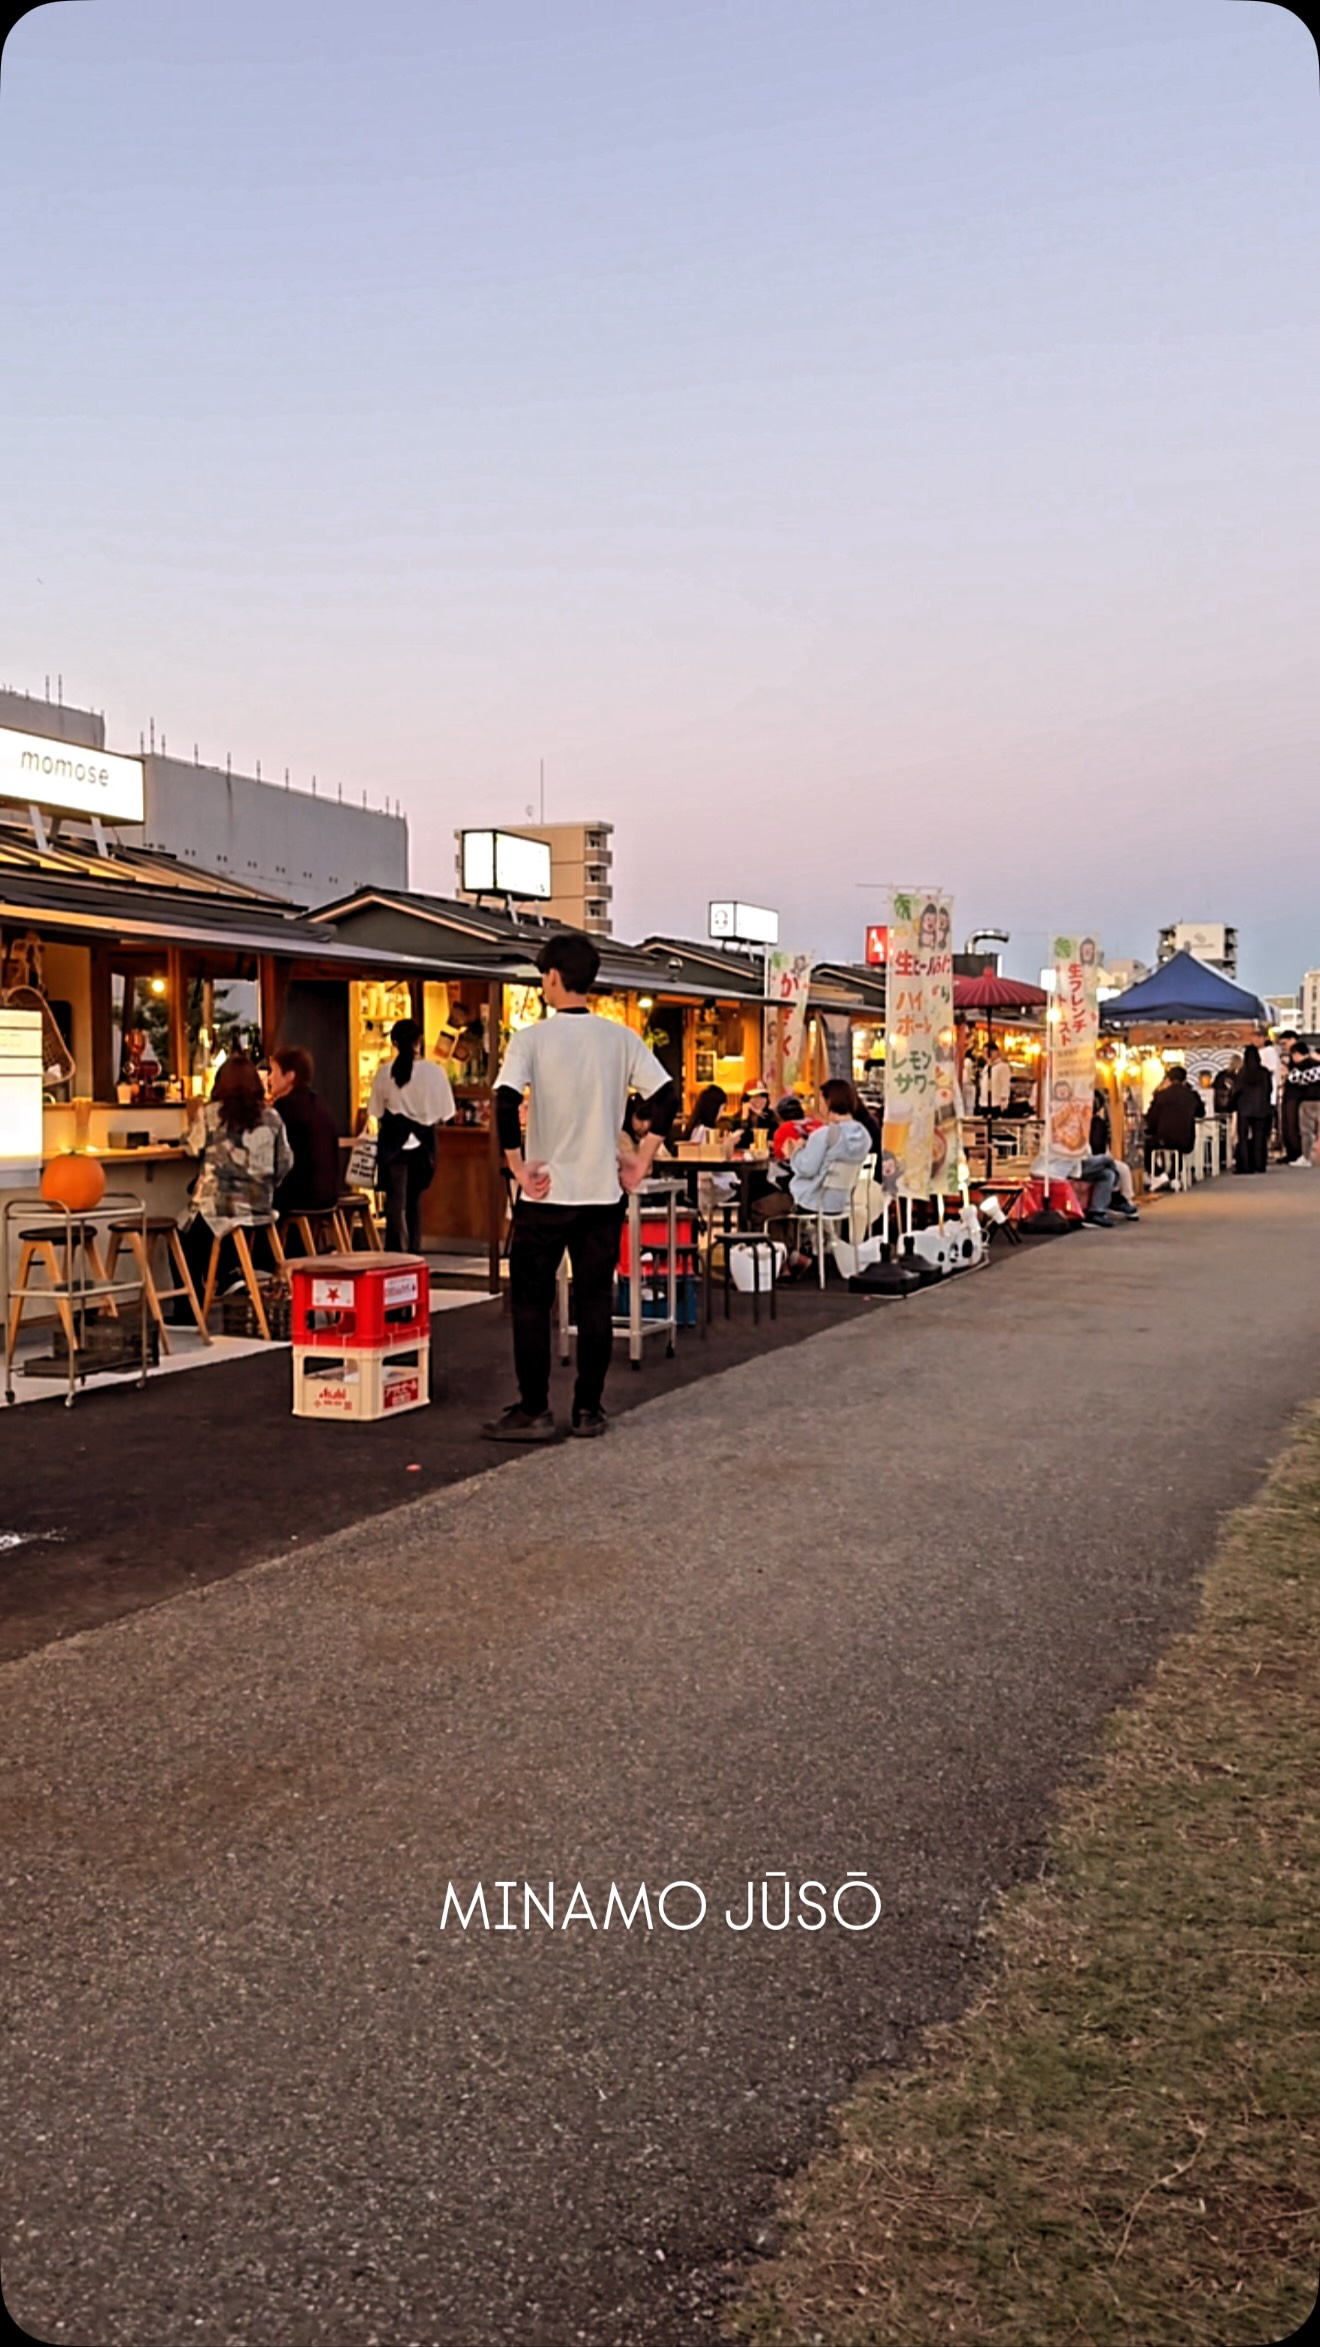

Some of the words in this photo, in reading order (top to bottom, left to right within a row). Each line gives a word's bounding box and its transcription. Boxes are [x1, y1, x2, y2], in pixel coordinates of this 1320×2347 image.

[20, 751, 109, 787] momose
[1068, 963, 1087, 1033] 生フレンチ
[892, 1051, 932, 1071] レモン
[895, 1074, 936, 1094] サワー
